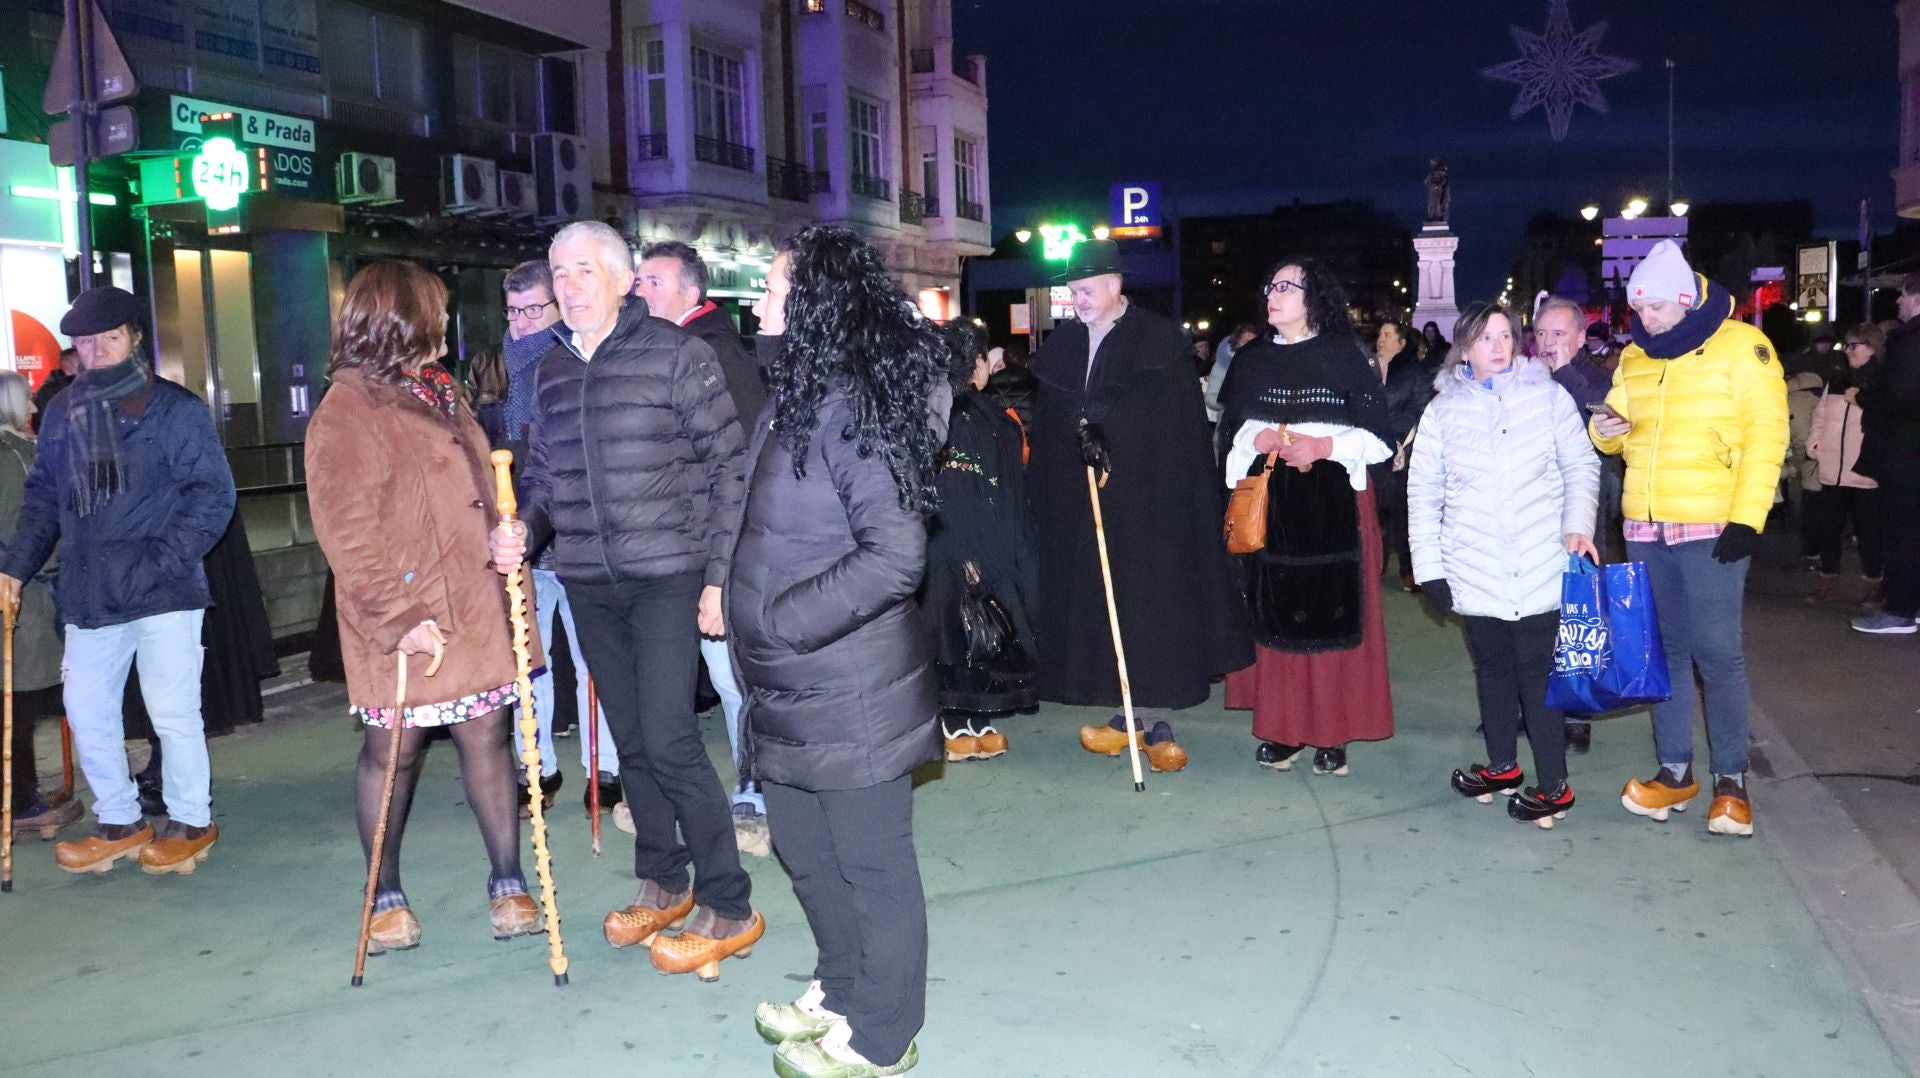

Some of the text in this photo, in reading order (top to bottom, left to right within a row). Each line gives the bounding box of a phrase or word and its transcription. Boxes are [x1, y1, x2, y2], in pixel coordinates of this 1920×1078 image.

[176, 103, 311, 143] Cre & Prada
[200, 160, 242, 187] 24h
[1123, 187, 1149, 225] P
[1134, 215, 1148, 224] 24h
[1566, 603, 1588, 615] VAS A
